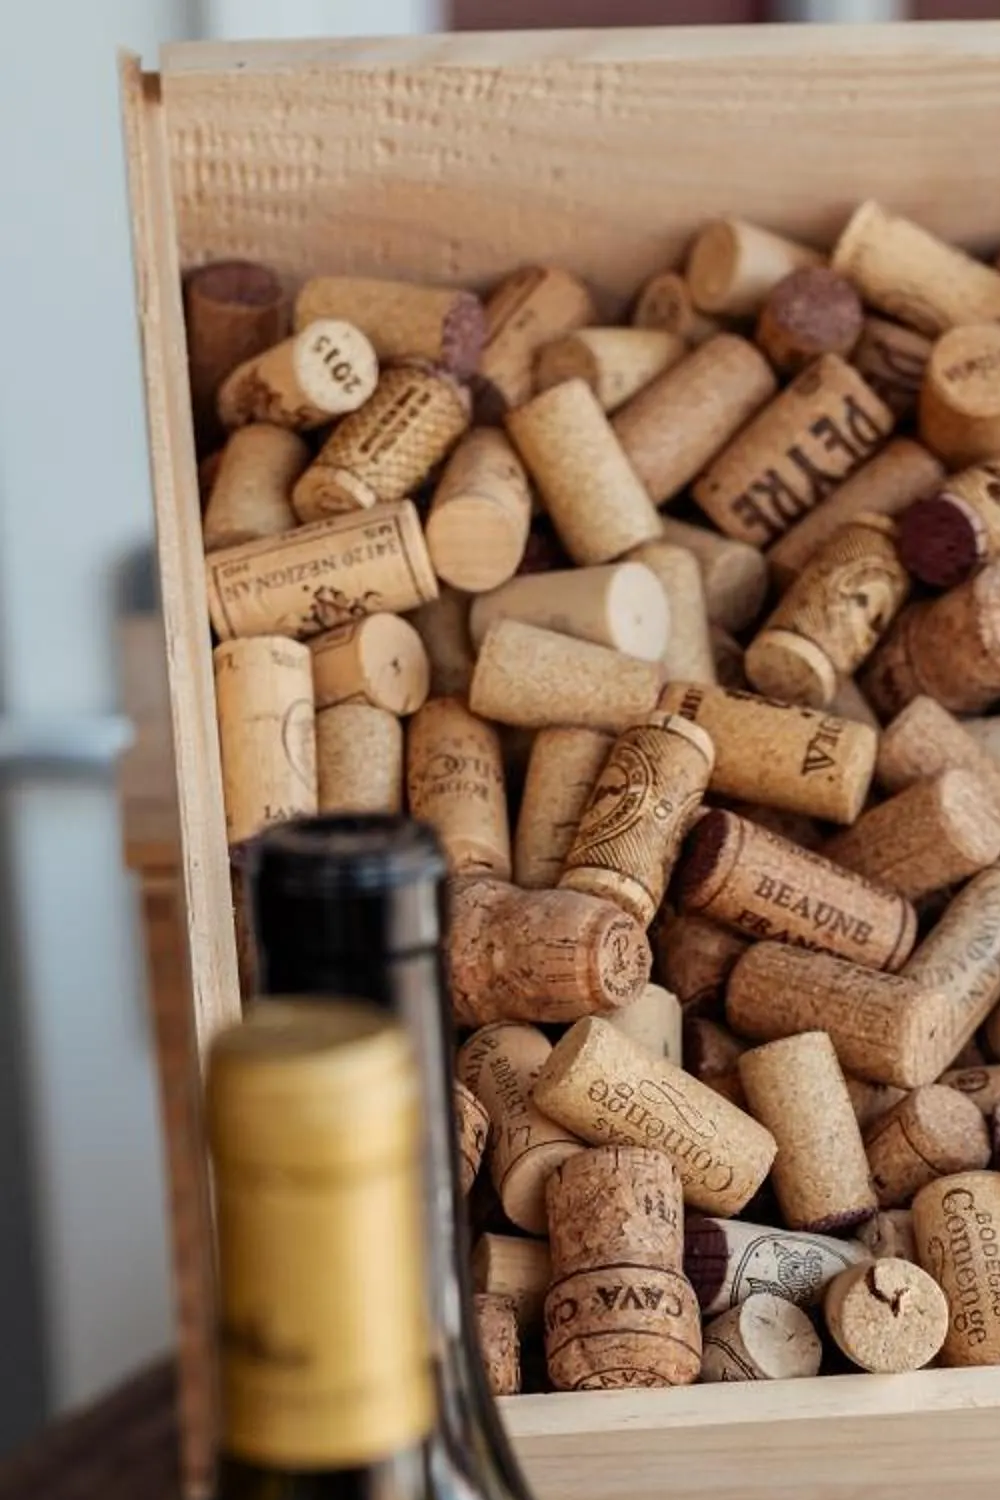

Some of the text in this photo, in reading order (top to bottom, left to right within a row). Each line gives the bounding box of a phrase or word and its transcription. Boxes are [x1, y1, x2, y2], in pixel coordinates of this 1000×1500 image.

[313, 334, 362, 395] 2015
[754, 873, 874, 947] BEAUNE
[595, 1283, 684, 1319] CAVA
[940, 1187, 988, 1349] Comenge
